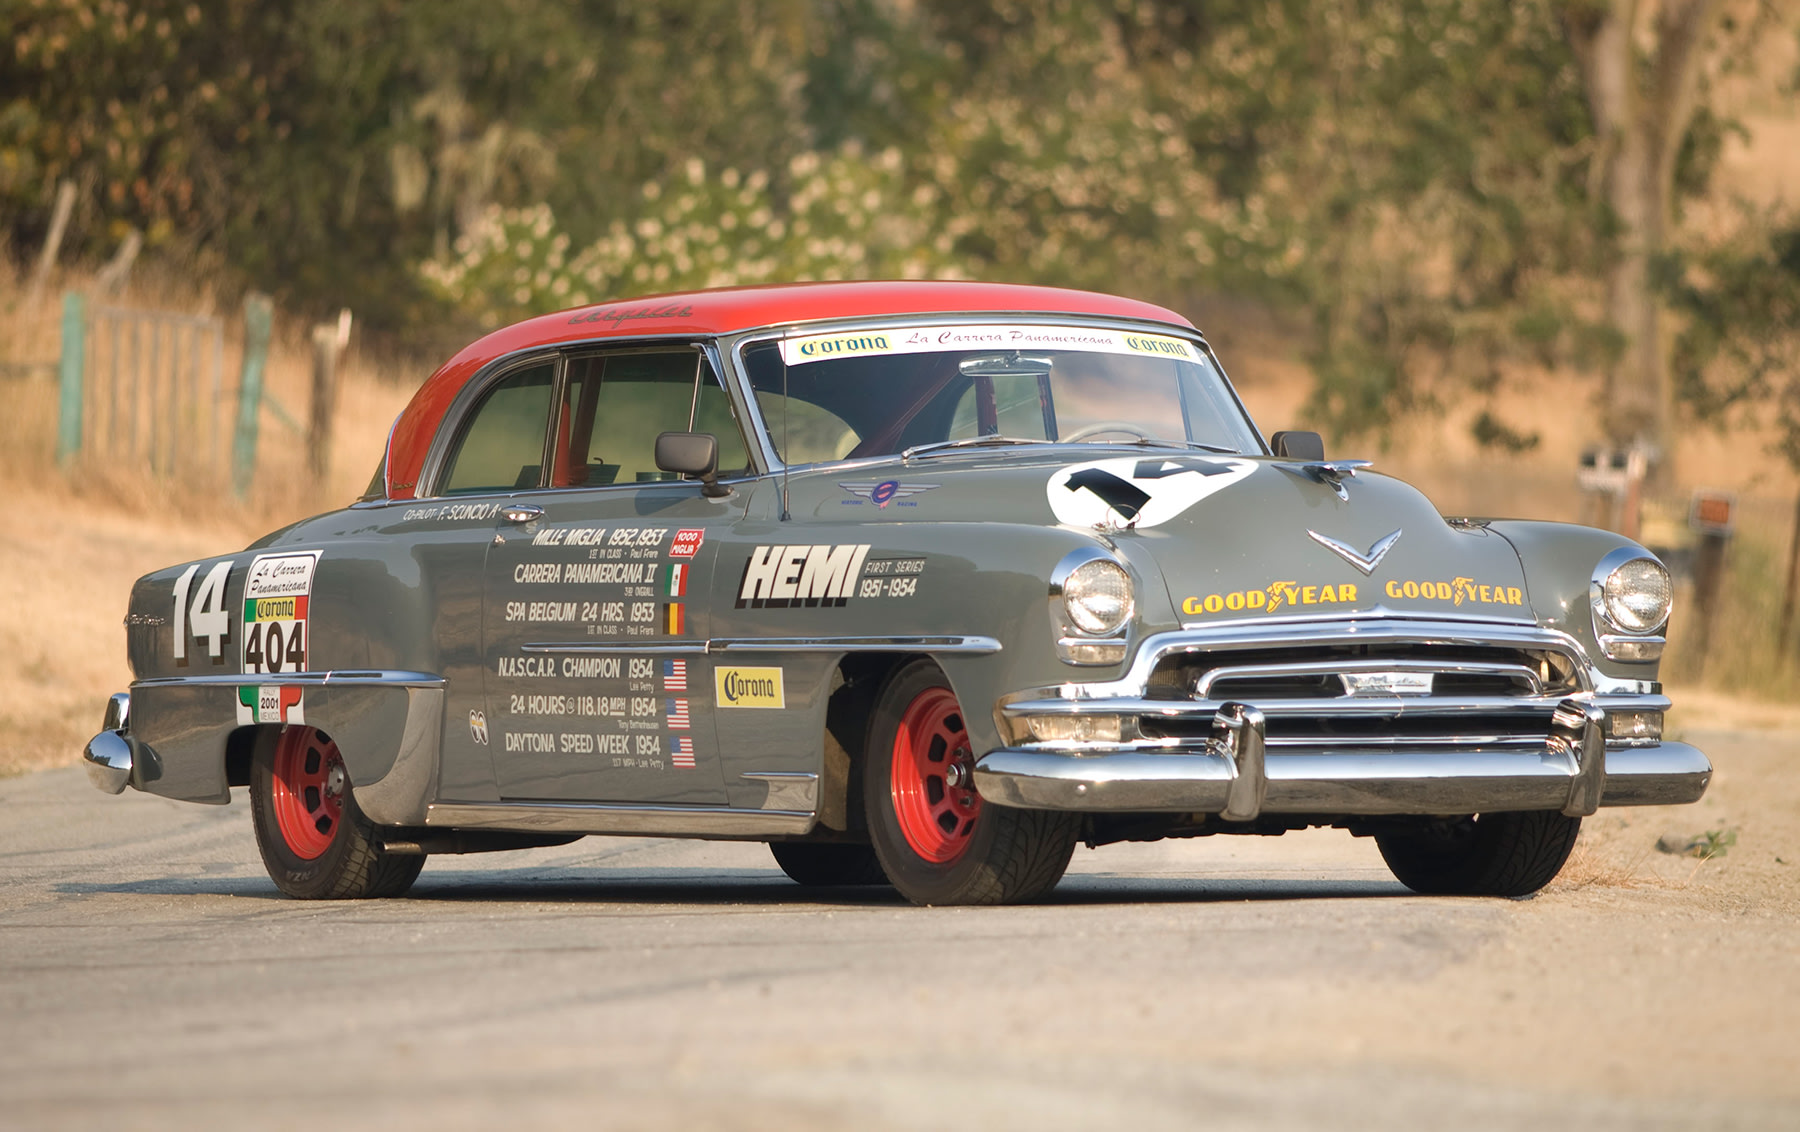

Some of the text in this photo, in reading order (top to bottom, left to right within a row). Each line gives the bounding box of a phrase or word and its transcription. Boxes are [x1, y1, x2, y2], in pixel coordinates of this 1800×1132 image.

[800, 336, 889, 355] Corona
[905, 330, 1113, 345] La Carrera Panamericana
[1127, 336, 1190, 358] Corona
[1063, 457, 1244, 521] 14
[532, 528, 568, 546] MILLE
[563, 528, 606, 546] MIGLIA
[677, 532, 698, 542] 1000
[599, 549, 607, 559] IN
[606, 549, 622, 559] CLASS
[630, 549, 642, 559] Paul
[670, 544, 694, 554] MIGLIA
[256, 560, 306, 578] La Carrera
[514, 563, 658, 583] CARRERA PANAMERICANA II
[864, 560, 925, 573] FIRST SERIES
[736, 544, 871, 608] HEMI
[250, 579, 307, 595] Panamericana
[172, 560, 234, 662] 14
[257, 600, 294, 618] Corona
[505, 601, 655, 622] SPA BELGIUM 24 HRS. 1953
[603, 625, 618, 635] CLASS
[245, 621, 305, 674] 404
[498, 657, 654, 678] N.A.S.C.A.R. CHAMPION 1954
[263, 688, 276, 696] RALLY
[724, 671, 774, 704] Corona
[261, 698, 279, 709] 2001
[510, 694, 525, 714] 24
[528, 695, 566, 714] HOURS
[577, 696, 609, 716] 118.18
[609, 697, 626, 713] MPH
[631, 697, 657, 717] 1954
[260, 711, 280, 721] MEXICO
[505, 732, 661, 755] DAYTONA SPEED WEEK 1954
